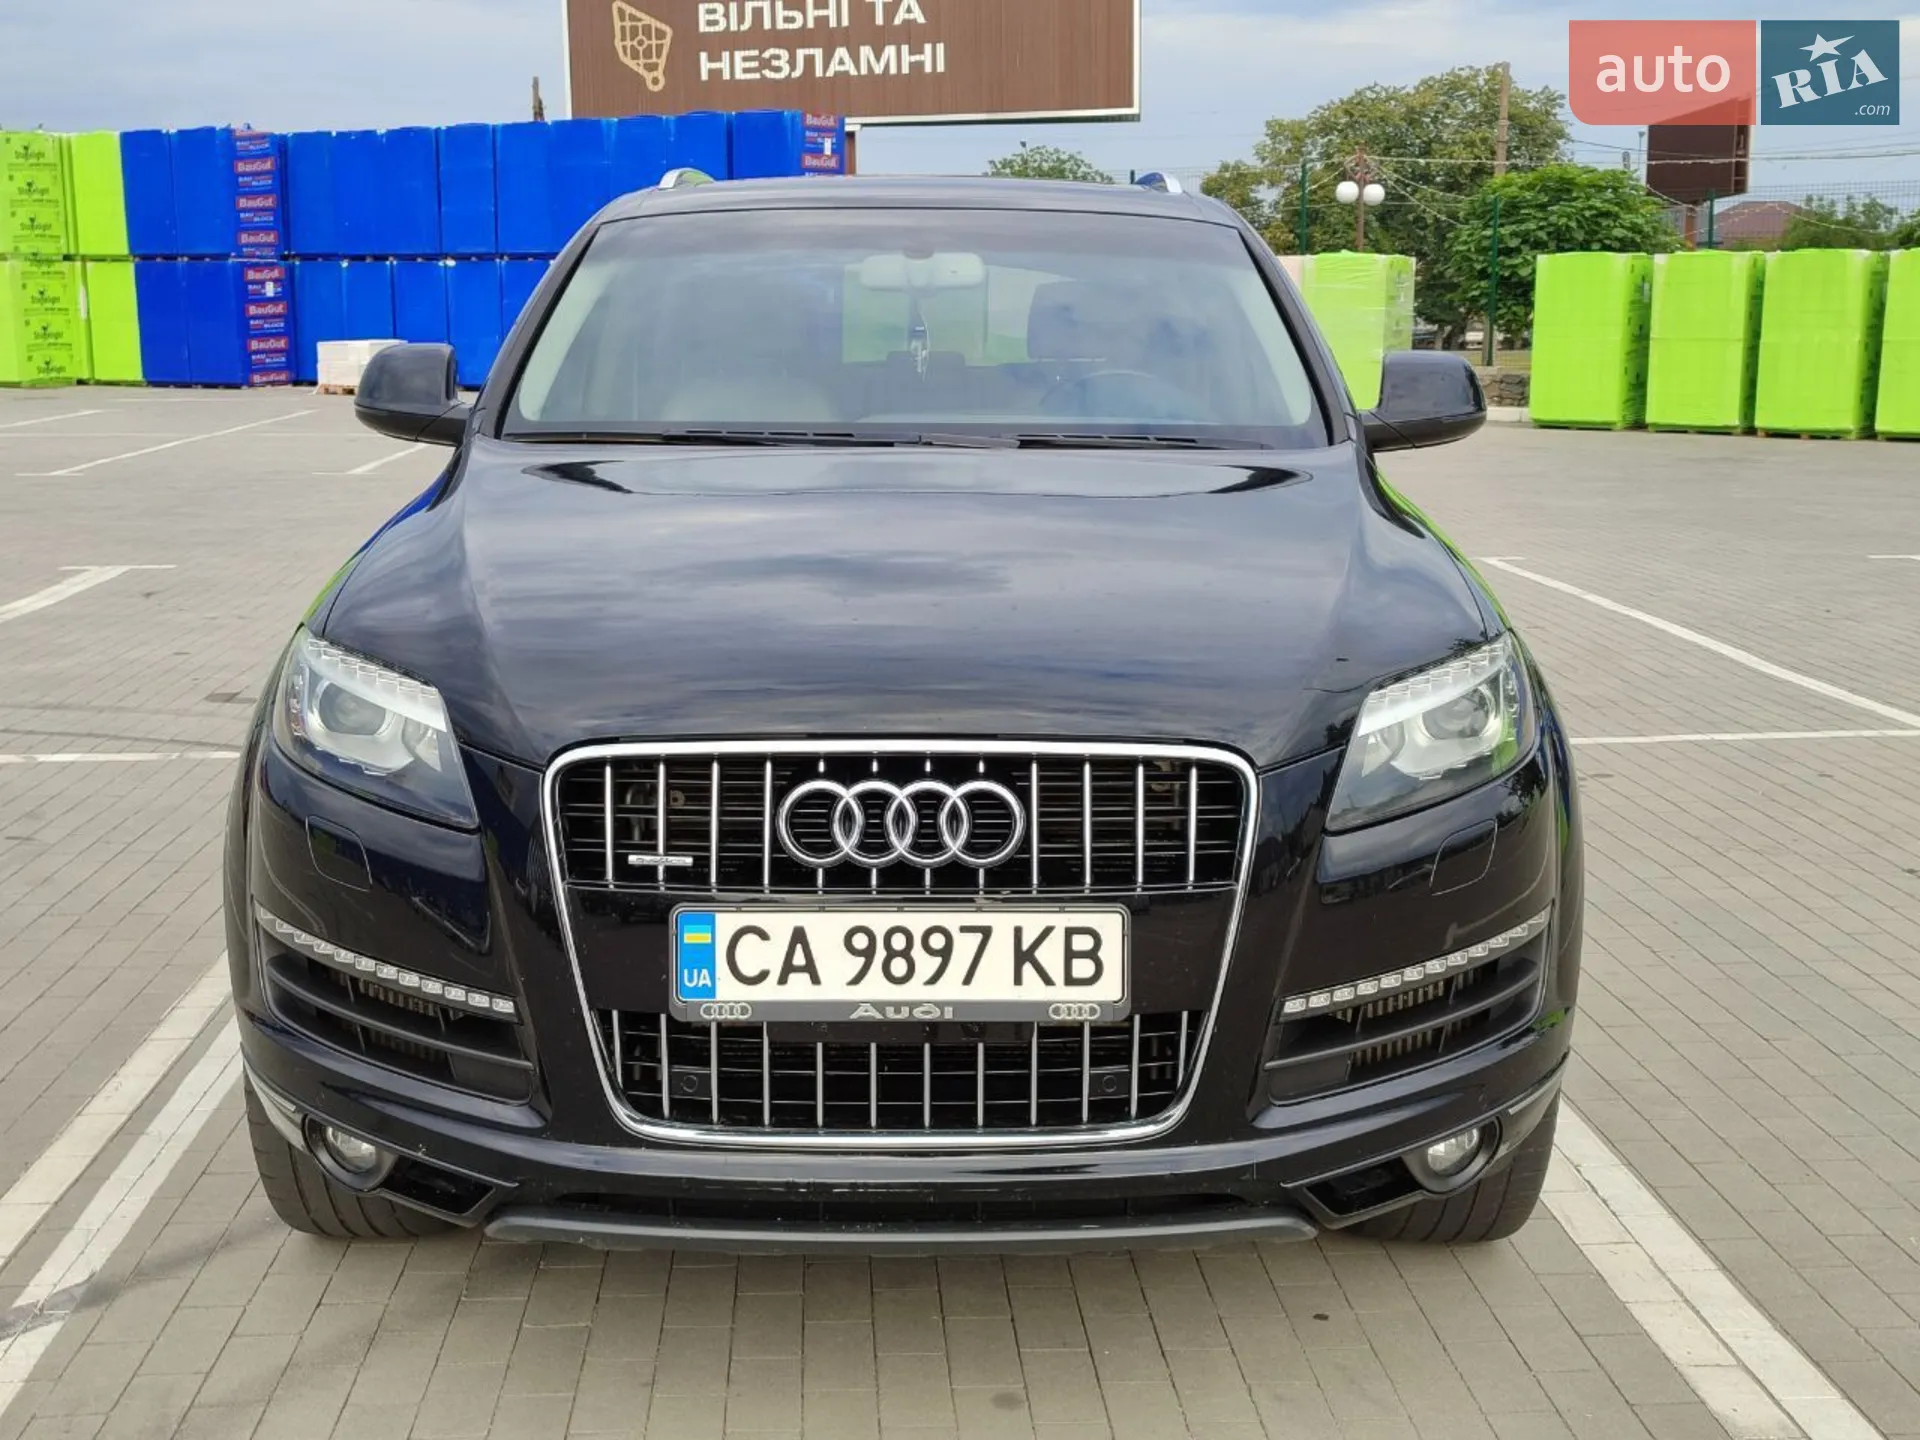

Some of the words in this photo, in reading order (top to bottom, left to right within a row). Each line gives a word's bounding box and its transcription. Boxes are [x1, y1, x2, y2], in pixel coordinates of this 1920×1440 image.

[698, 0, 849, 32] ВІЛЬНІ
[865, 0, 928, 26] ТА
[699, 42, 946, 81] НЕЗЛАМНІ
[238, 159, 273, 172] BauGut
[239, 196, 274, 208] BauGut
[241, 232, 276, 244] BauGut
[248, 268, 280, 280] BauGut
[249, 303, 285, 315] BauGut
[251, 338, 286, 350] BauGut
[253, 372, 287, 384] BauGut
[725, 925, 822, 986] CA
[843, 925, 993, 986] 9897
[1013, 925, 1104, 986] KB
[684, 969, 712, 987] UA
[849, 1003, 954, 1020] Audi
